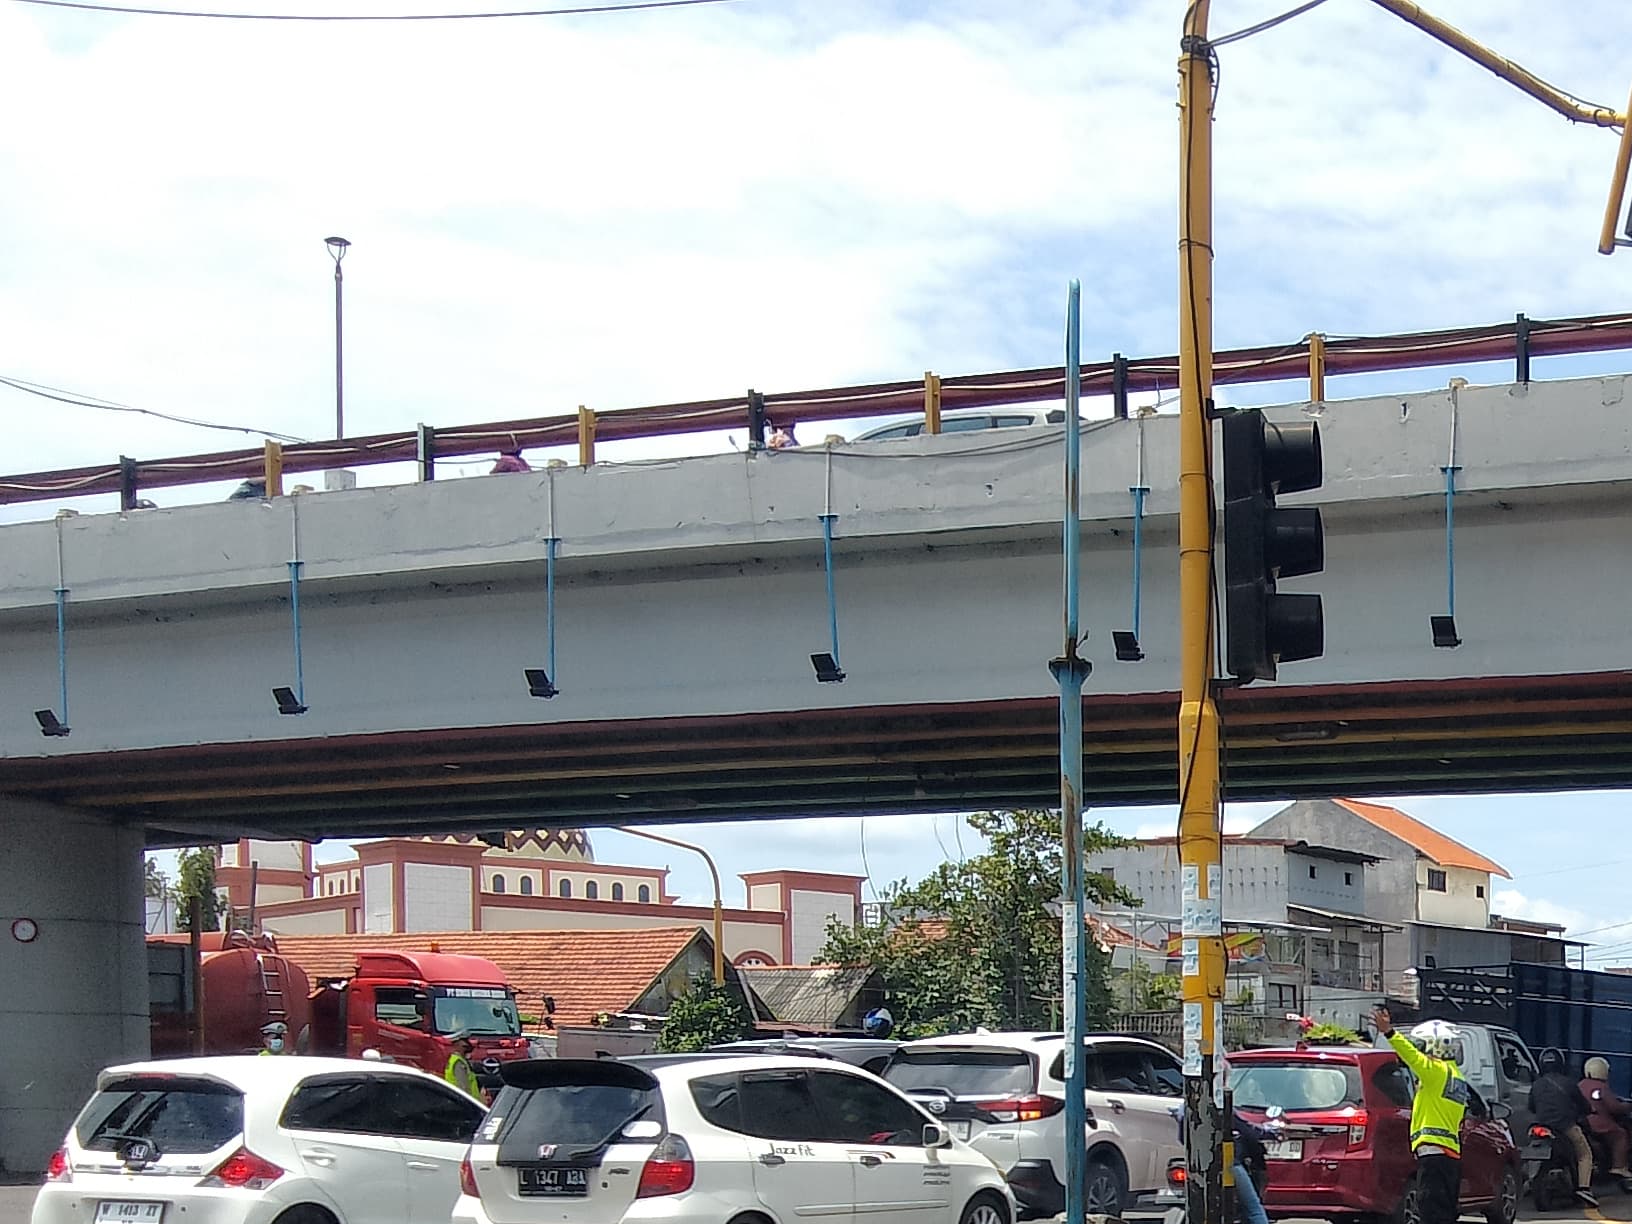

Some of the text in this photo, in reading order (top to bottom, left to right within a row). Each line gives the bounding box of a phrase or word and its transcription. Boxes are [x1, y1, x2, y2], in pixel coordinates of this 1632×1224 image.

[765, 1142, 797, 1156] Jazz
[520, 1170, 586, 1185] L 1347 ABA
[102, 1203, 112, 1215] W
